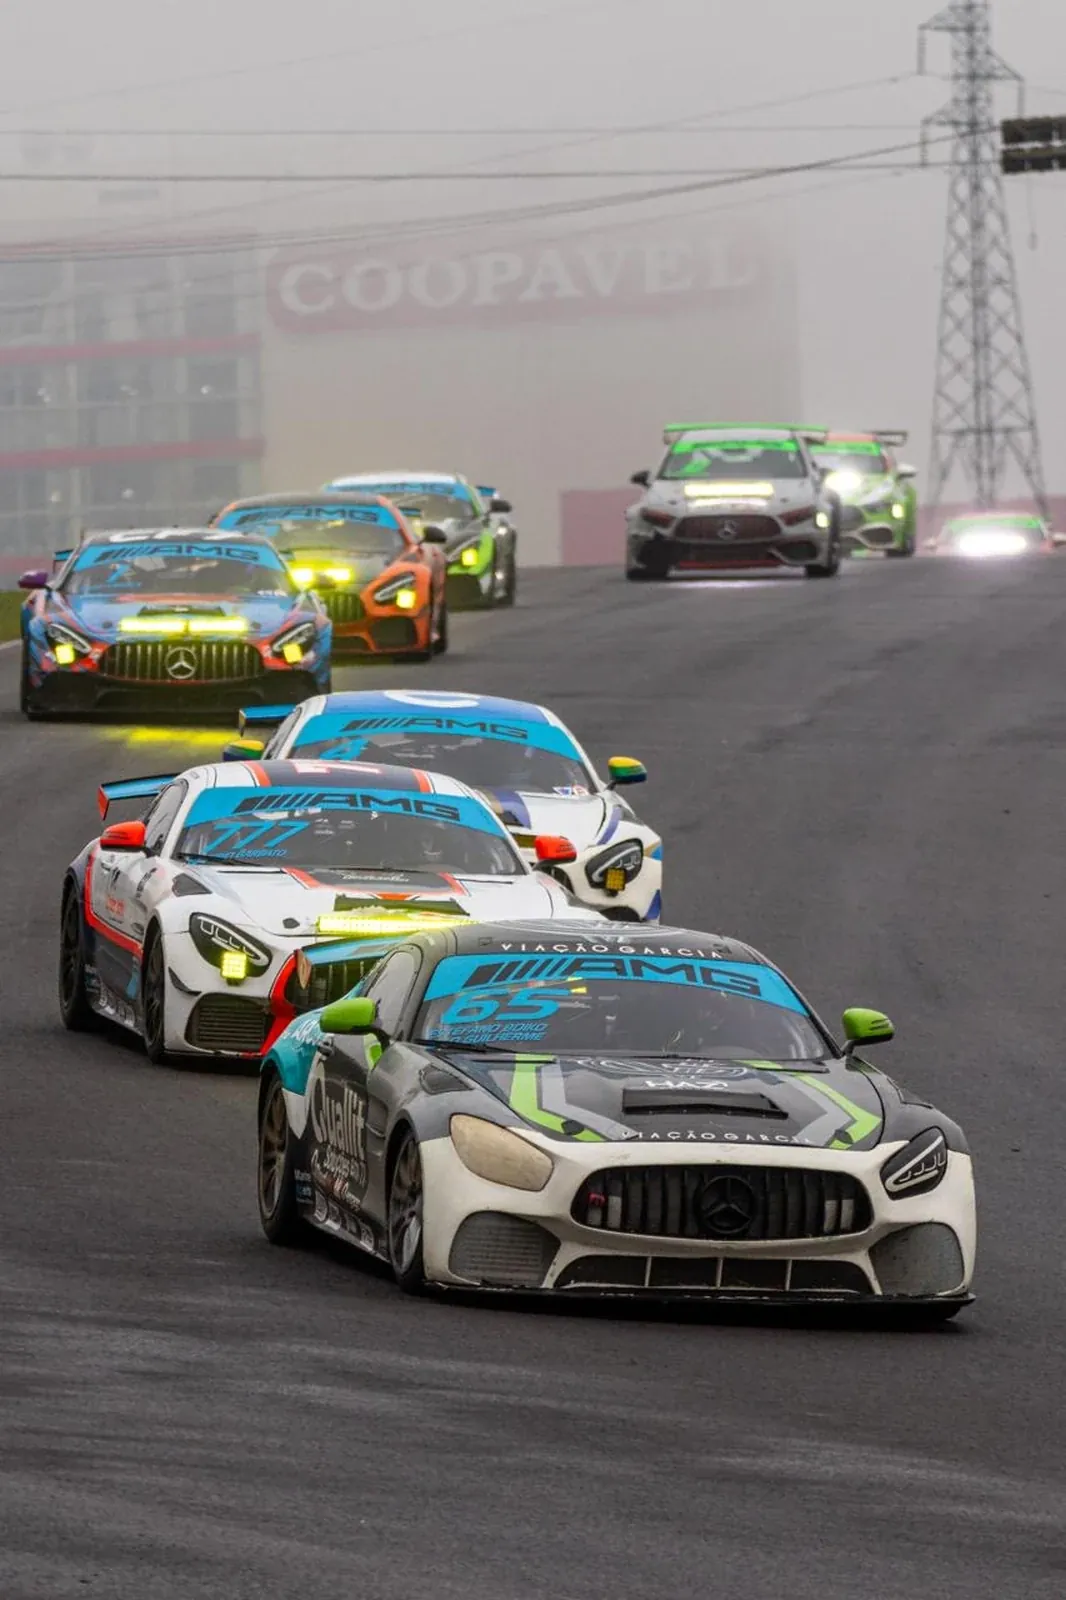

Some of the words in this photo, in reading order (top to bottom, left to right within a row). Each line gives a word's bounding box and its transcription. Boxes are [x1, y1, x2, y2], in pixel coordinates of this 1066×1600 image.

[278, 238, 758, 315] COOPAVEL
[283, 507, 378, 522] AMG
[146, 544, 261, 562] AMG
[402, 716, 529, 740] AMG
[308, 792, 461, 822] AMG
[204, 820, 310, 854] 777
[501, 942, 609, 954] VIAÇÃO
[619, 945, 723, 959] GARCIA
[560, 957, 762, 997] AMG
[440, 987, 571, 1025] 65
[621, 1129, 716, 1141] VIAÇÃO
